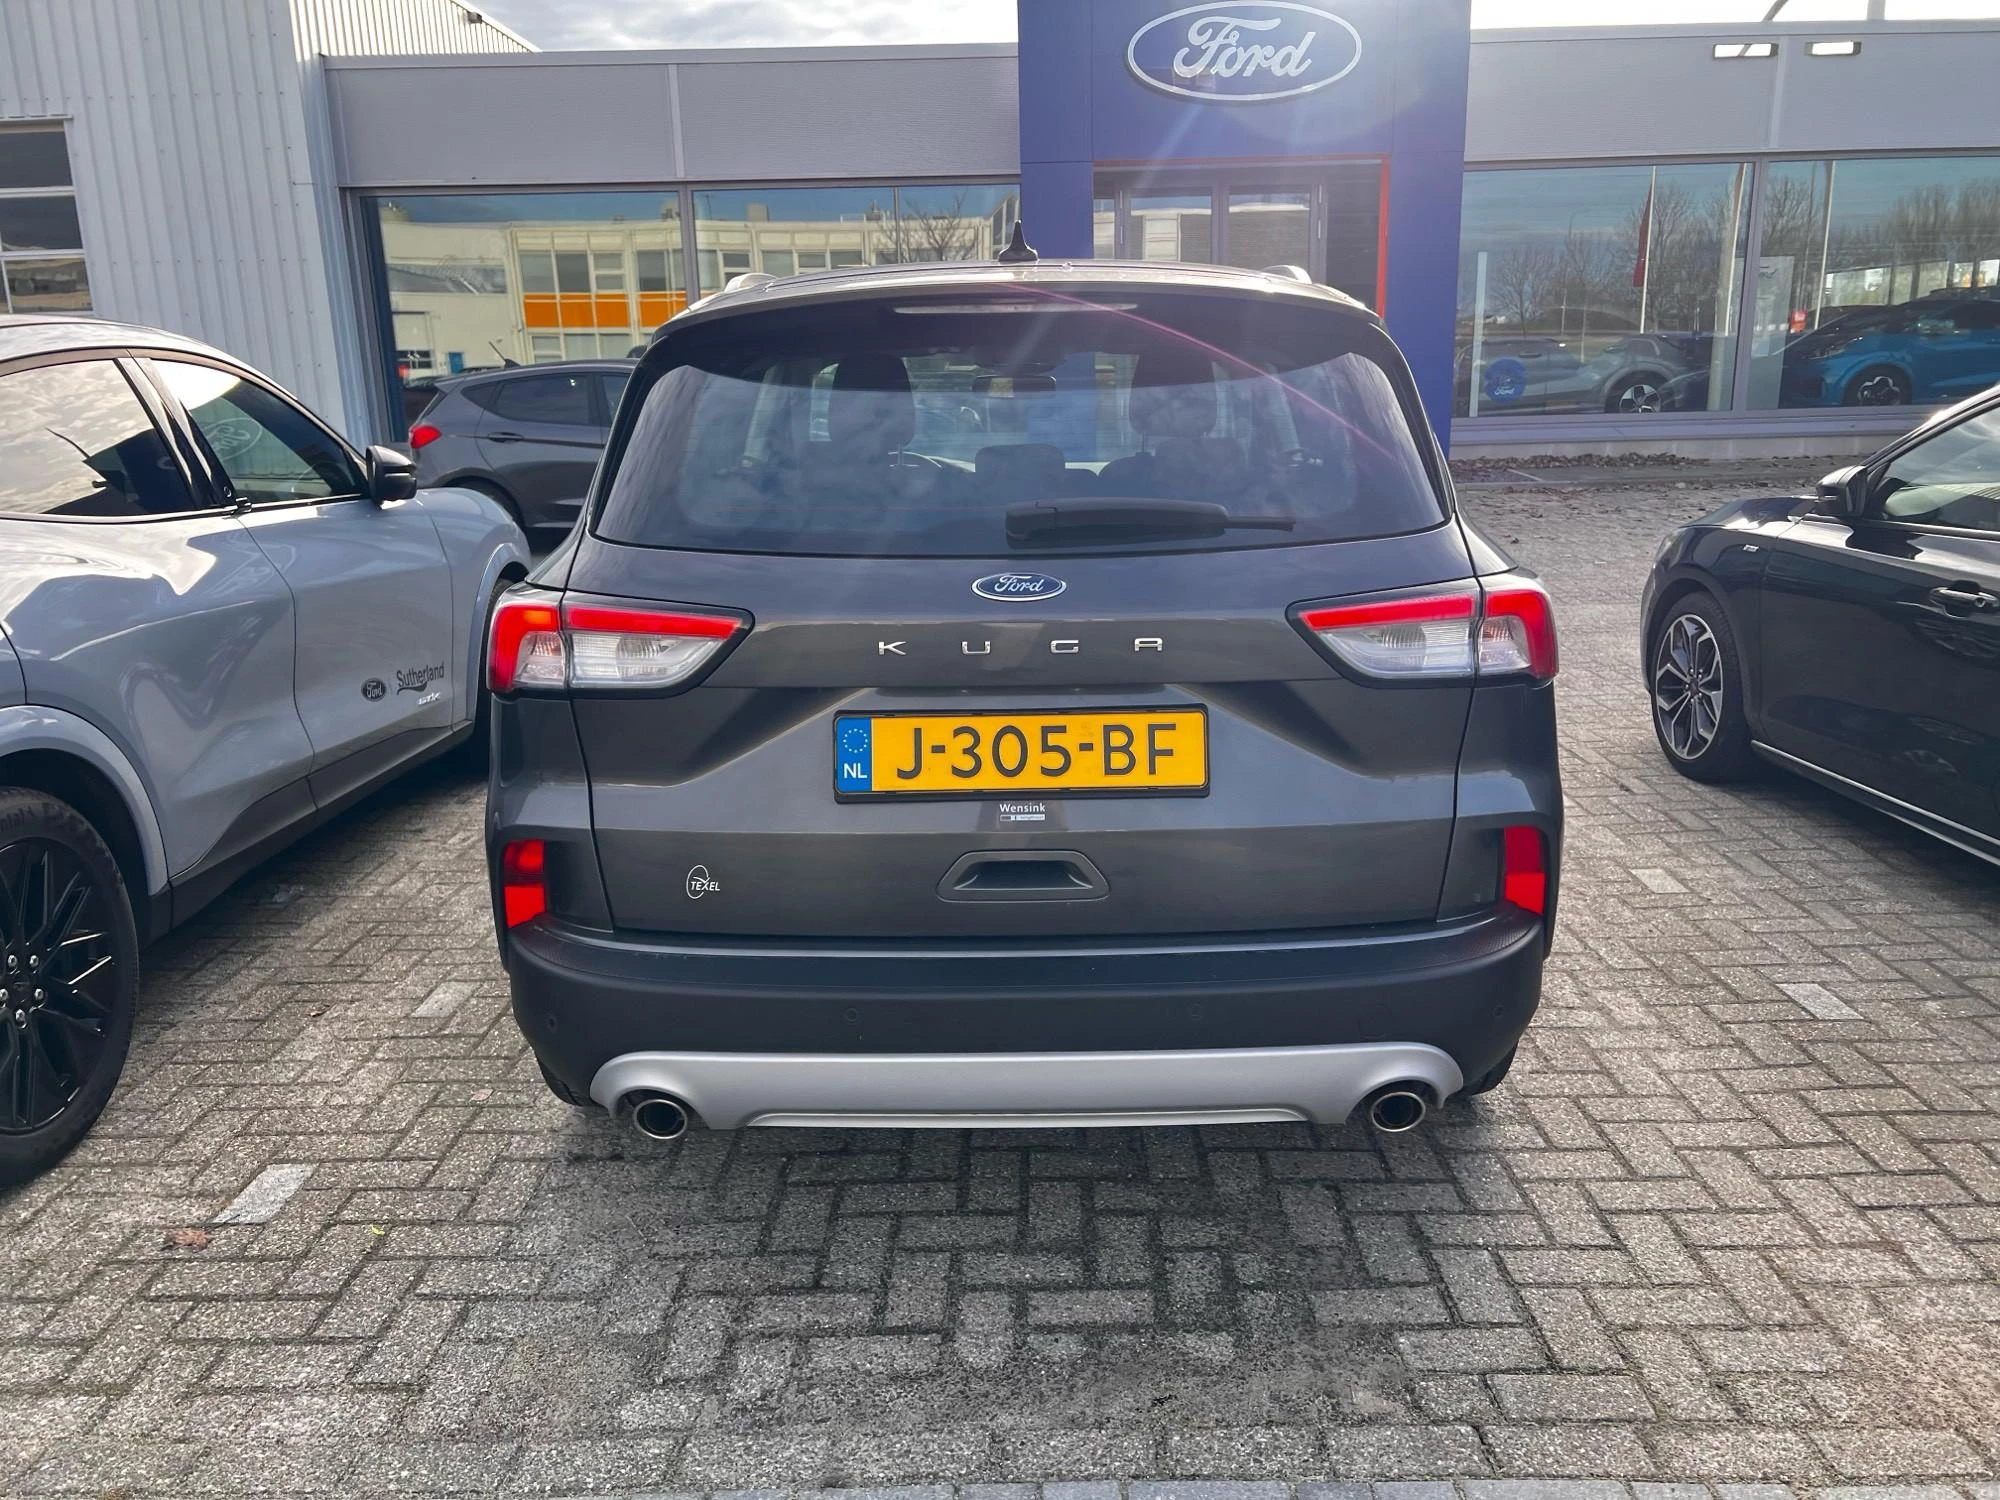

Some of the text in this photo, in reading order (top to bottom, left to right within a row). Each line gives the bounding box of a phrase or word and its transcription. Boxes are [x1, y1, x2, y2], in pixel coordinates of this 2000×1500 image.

[1173, 15, 1316, 78] Ford
[994, 574, 1045, 592] Ford
[878, 637, 1164, 656] KUGA
[396, 661, 445, 688] Sutherland
[896, 723, 1177, 780] J-305-BF
[843, 763, 868, 779] NL
[999, 802, 1046, 813] Wensink
[690, 881, 721, 892] TEXEL
